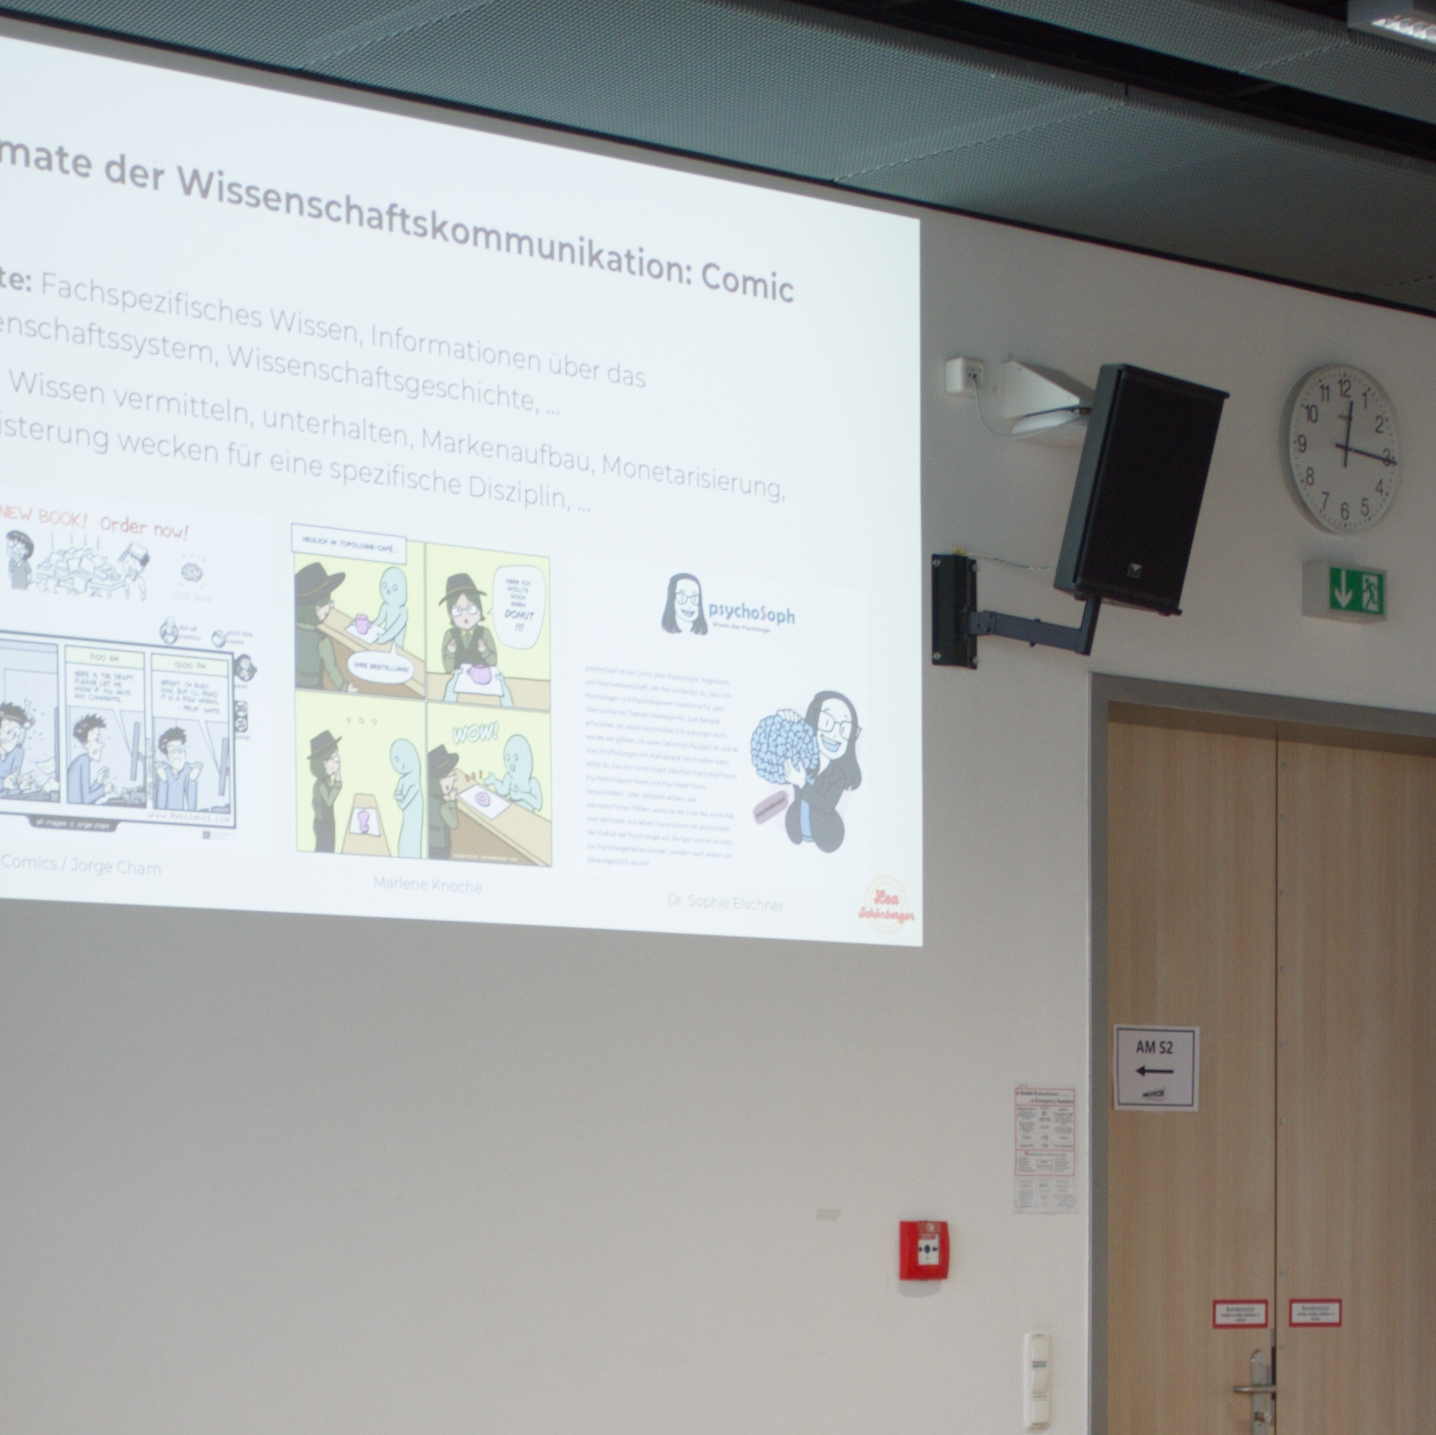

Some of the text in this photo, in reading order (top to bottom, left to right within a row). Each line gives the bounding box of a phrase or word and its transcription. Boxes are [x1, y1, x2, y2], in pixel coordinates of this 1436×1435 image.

[104, 154, 164, 191] der
[177, 165, 693, 286] Wissenschaftskommunikation:
[701, 263, 795, 303] Comic
[41, 271, 262, 329] Fachspezifisches
[270, 308, 363, 349] Wissen,
[371, 324, 541, 372] Informationen
[549, 352, 600, 383] über
[607, 362, 647, 390] das
[227, 343, 541, 416] Wissenschaftsgeschichte,
[1337, 379, 1352, 398] 12
[1319, 384, 1330, 402] 11
[1361, 392, 1368, 409] 1
[8, 368, 105, 405] Wissen
[113, 387, 256, 430] vermitteln,
[263, 409, 414, 451] unterhalten,
[422, 427, 596, 477] Markenaufbau,
[1305, 404, 1319, 423] 10
[1375, 415, 1384, 434] 2
[1297, 434, 1307, 453] 9
[118, 429, 218, 465] wecken
[227, 442, 262, 469] für
[270, 450, 323, 479] eine
[330, 461, 462, 496] spezifische
[469, 475, 572, 513] Disziplin,
[1306, 467, 1315, 486] 8
[1375, 479, 1384, 497] 4
[1321, 491, 1330, 509] 7
[1361, 498, 1370, 517] 5
[1341, 501, 1350, 520] 6
[39, 508, 88, 529] BOOK!
[100, 516, 147, 537] Order
[153, 523, 190, 541] now!
[709, 602, 795, 625] psychoSoph
[452, 720, 499, 746] WOW!
[0, 853, 58, 871] Comics
[70, 857, 113, 876] Jorge
[117, 860, 162, 876] Cham
[373, 875, 483, 894] Marlene Knoche
[668, 892, 784, 912] Dr. Sophie Elschner
[1136, 1040, 1174, 1054] AM S2
